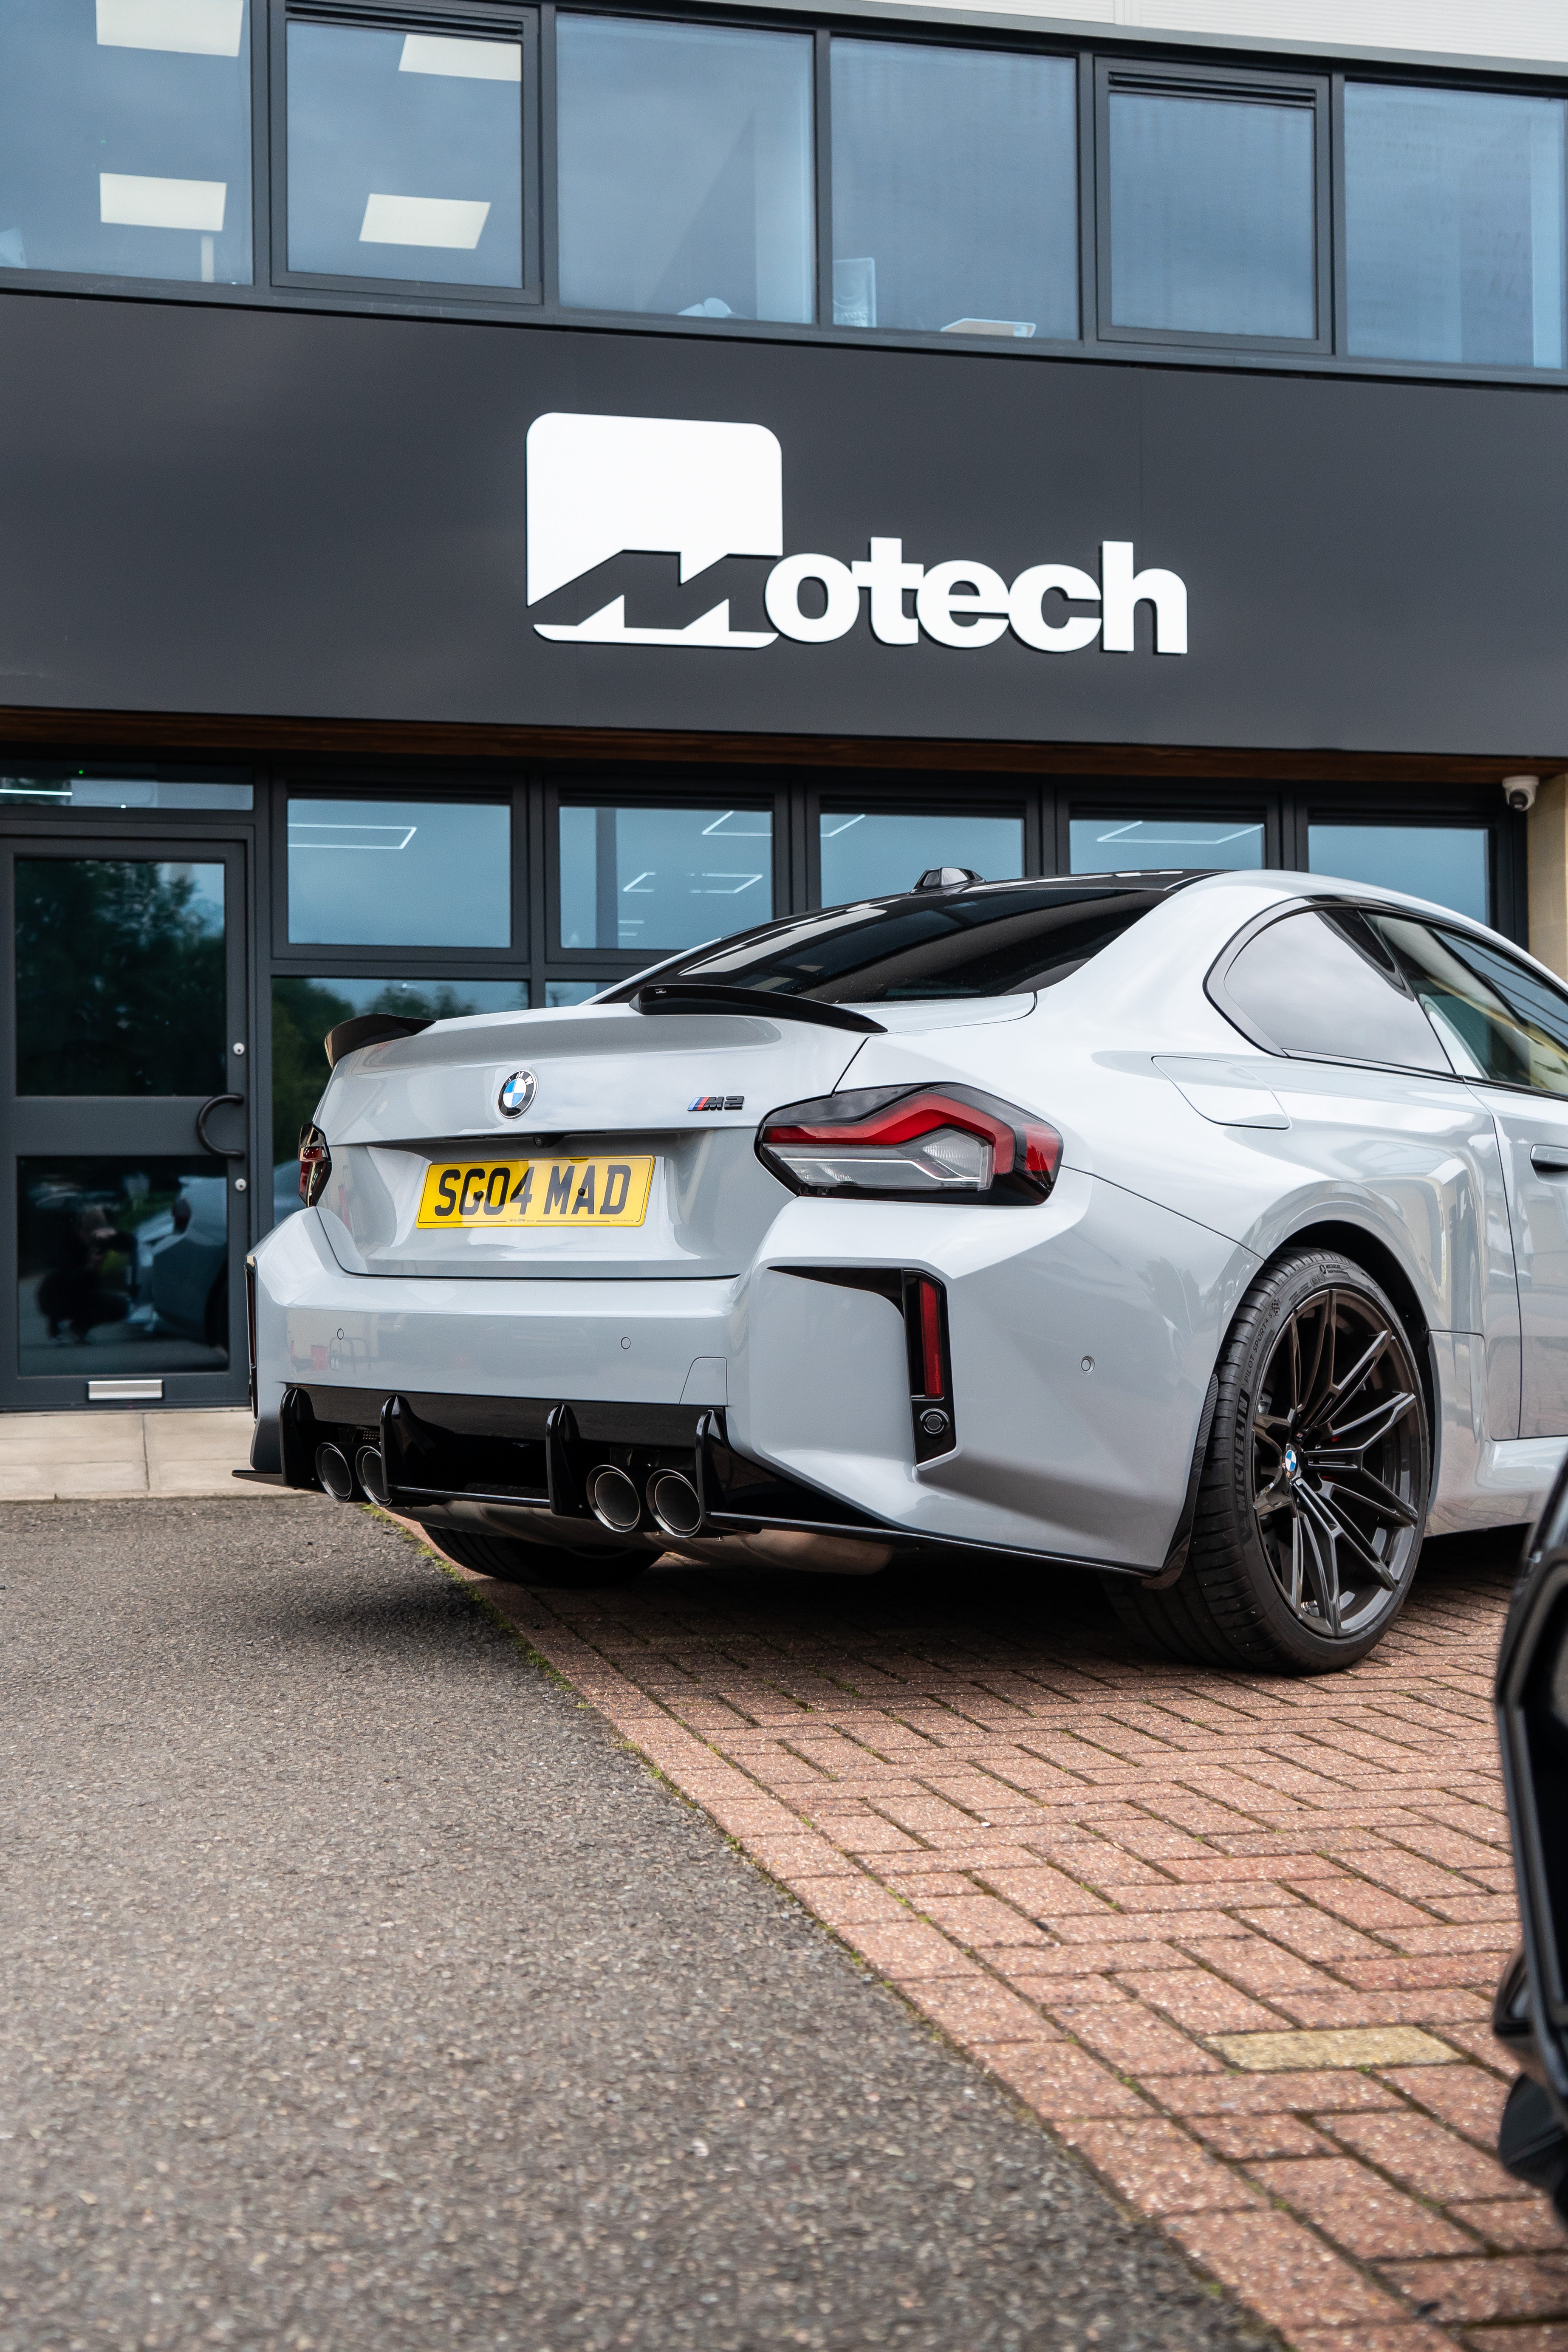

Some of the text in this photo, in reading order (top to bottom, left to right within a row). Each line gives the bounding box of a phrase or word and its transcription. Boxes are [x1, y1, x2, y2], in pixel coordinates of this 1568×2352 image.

[703, 1096, 745, 1111] M2
[434, 1165, 632, 1216] SG04 MAD
[1235, 1395, 1249, 1512] MICHELIN
[1244, 1354, 1255, 1384] PILOT
[1253, 1324, 1267, 1352] SPORT
